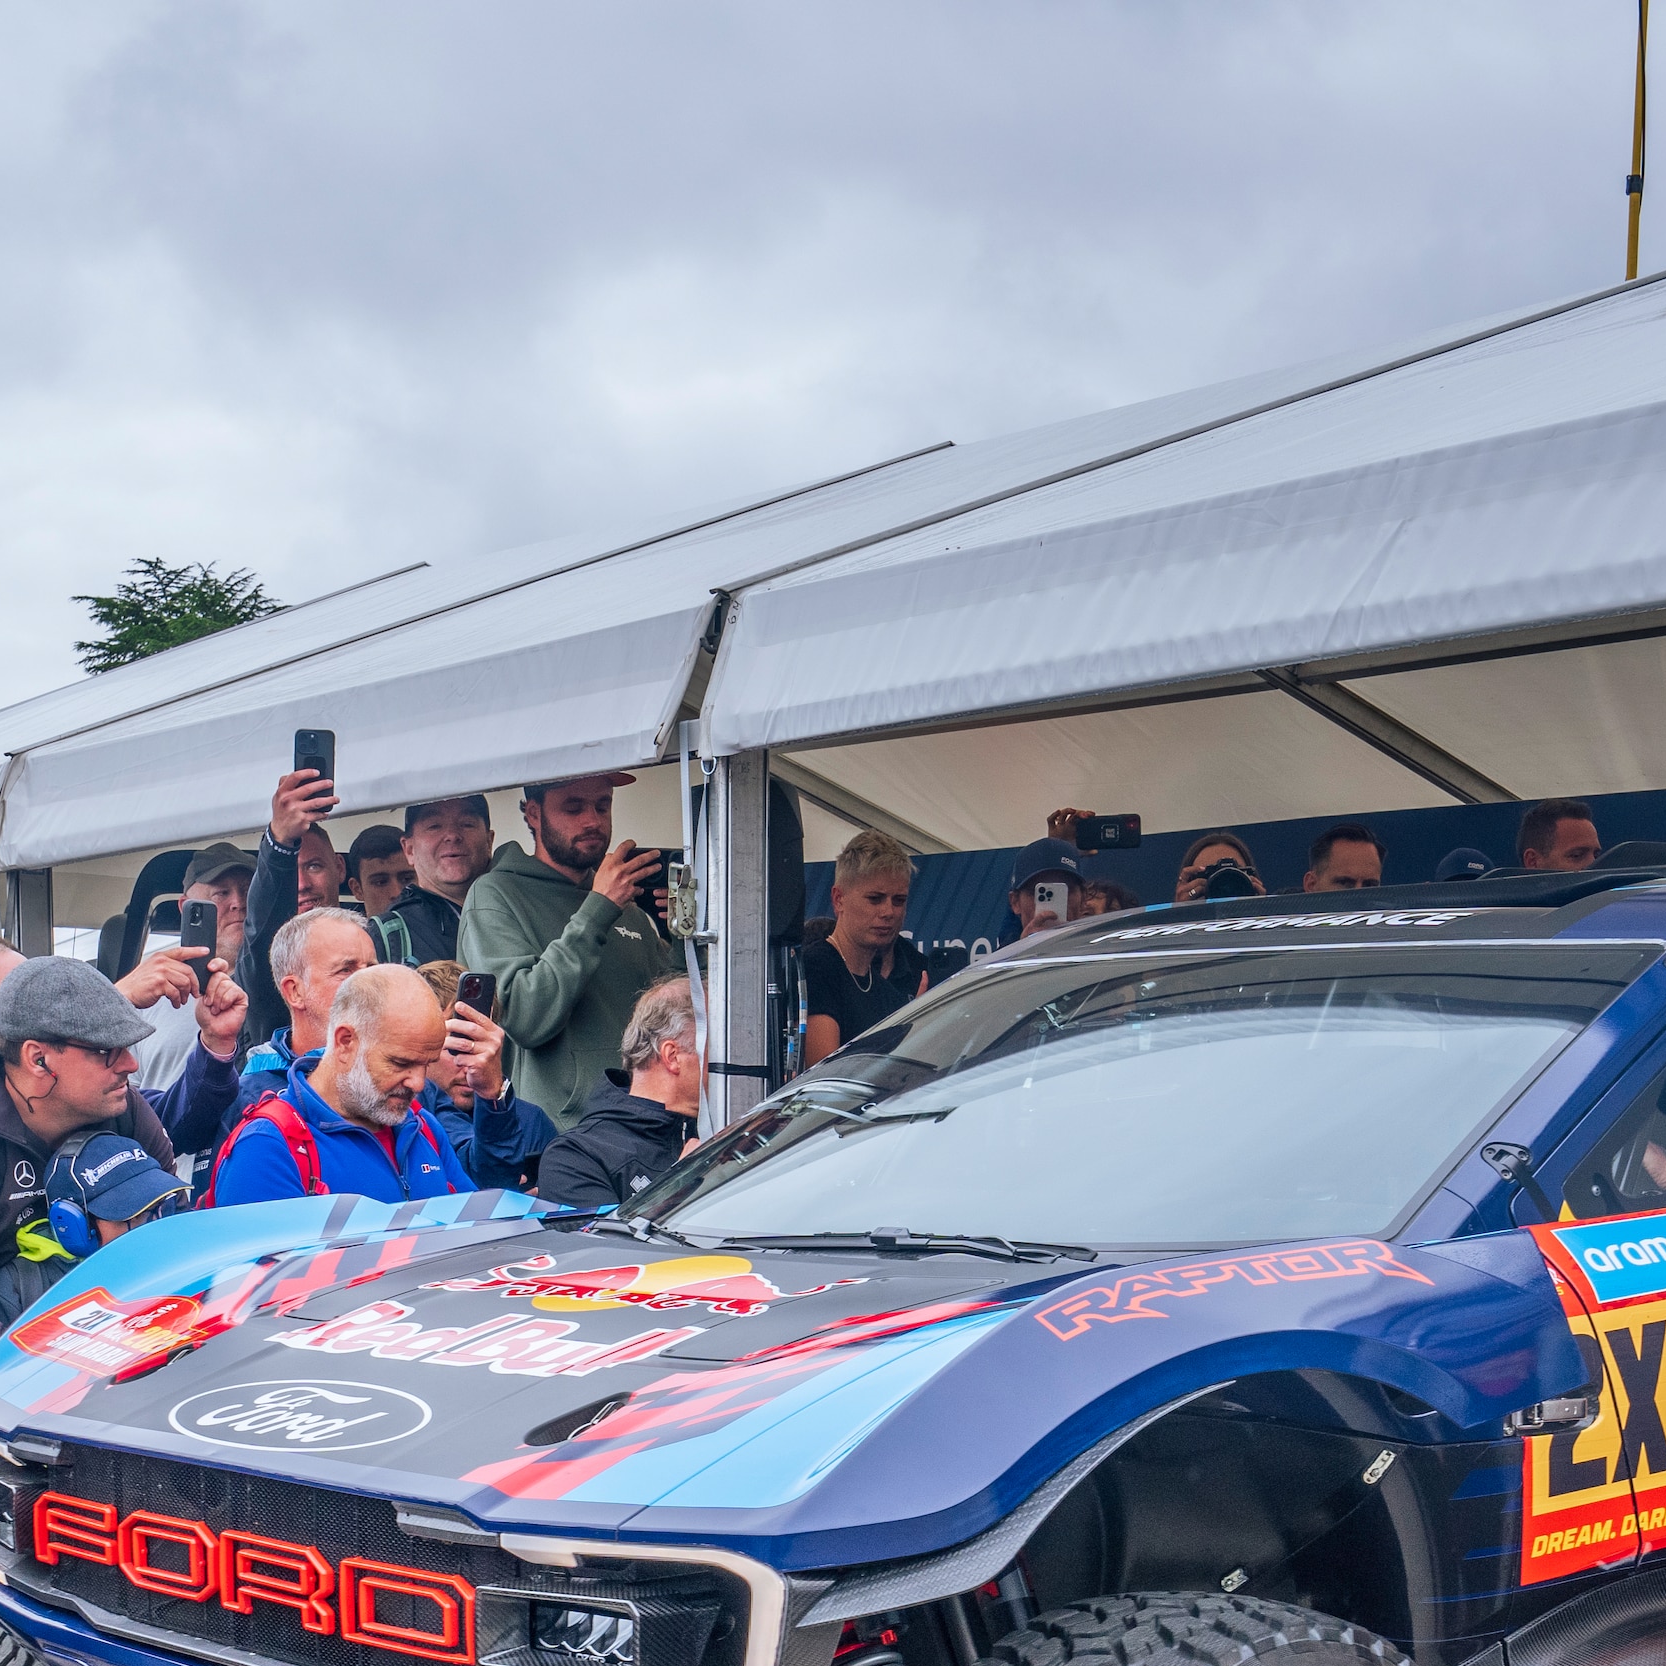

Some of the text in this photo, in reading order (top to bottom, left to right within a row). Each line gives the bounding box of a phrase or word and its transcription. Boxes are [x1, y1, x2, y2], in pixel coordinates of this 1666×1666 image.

[1089, 911, 1475, 945] PERFORMANCE
[1034, 1239, 1436, 1342] RAPTOR
[71, 1310, 117, 1332] 2XX
[263, 1300, 709, 1377] Red Bull
[196, 1386, 389, 1443] Ford
[1531, 1520, 1616, 1558] DREAM.
[33, 1491, 477, 1666] FORD
